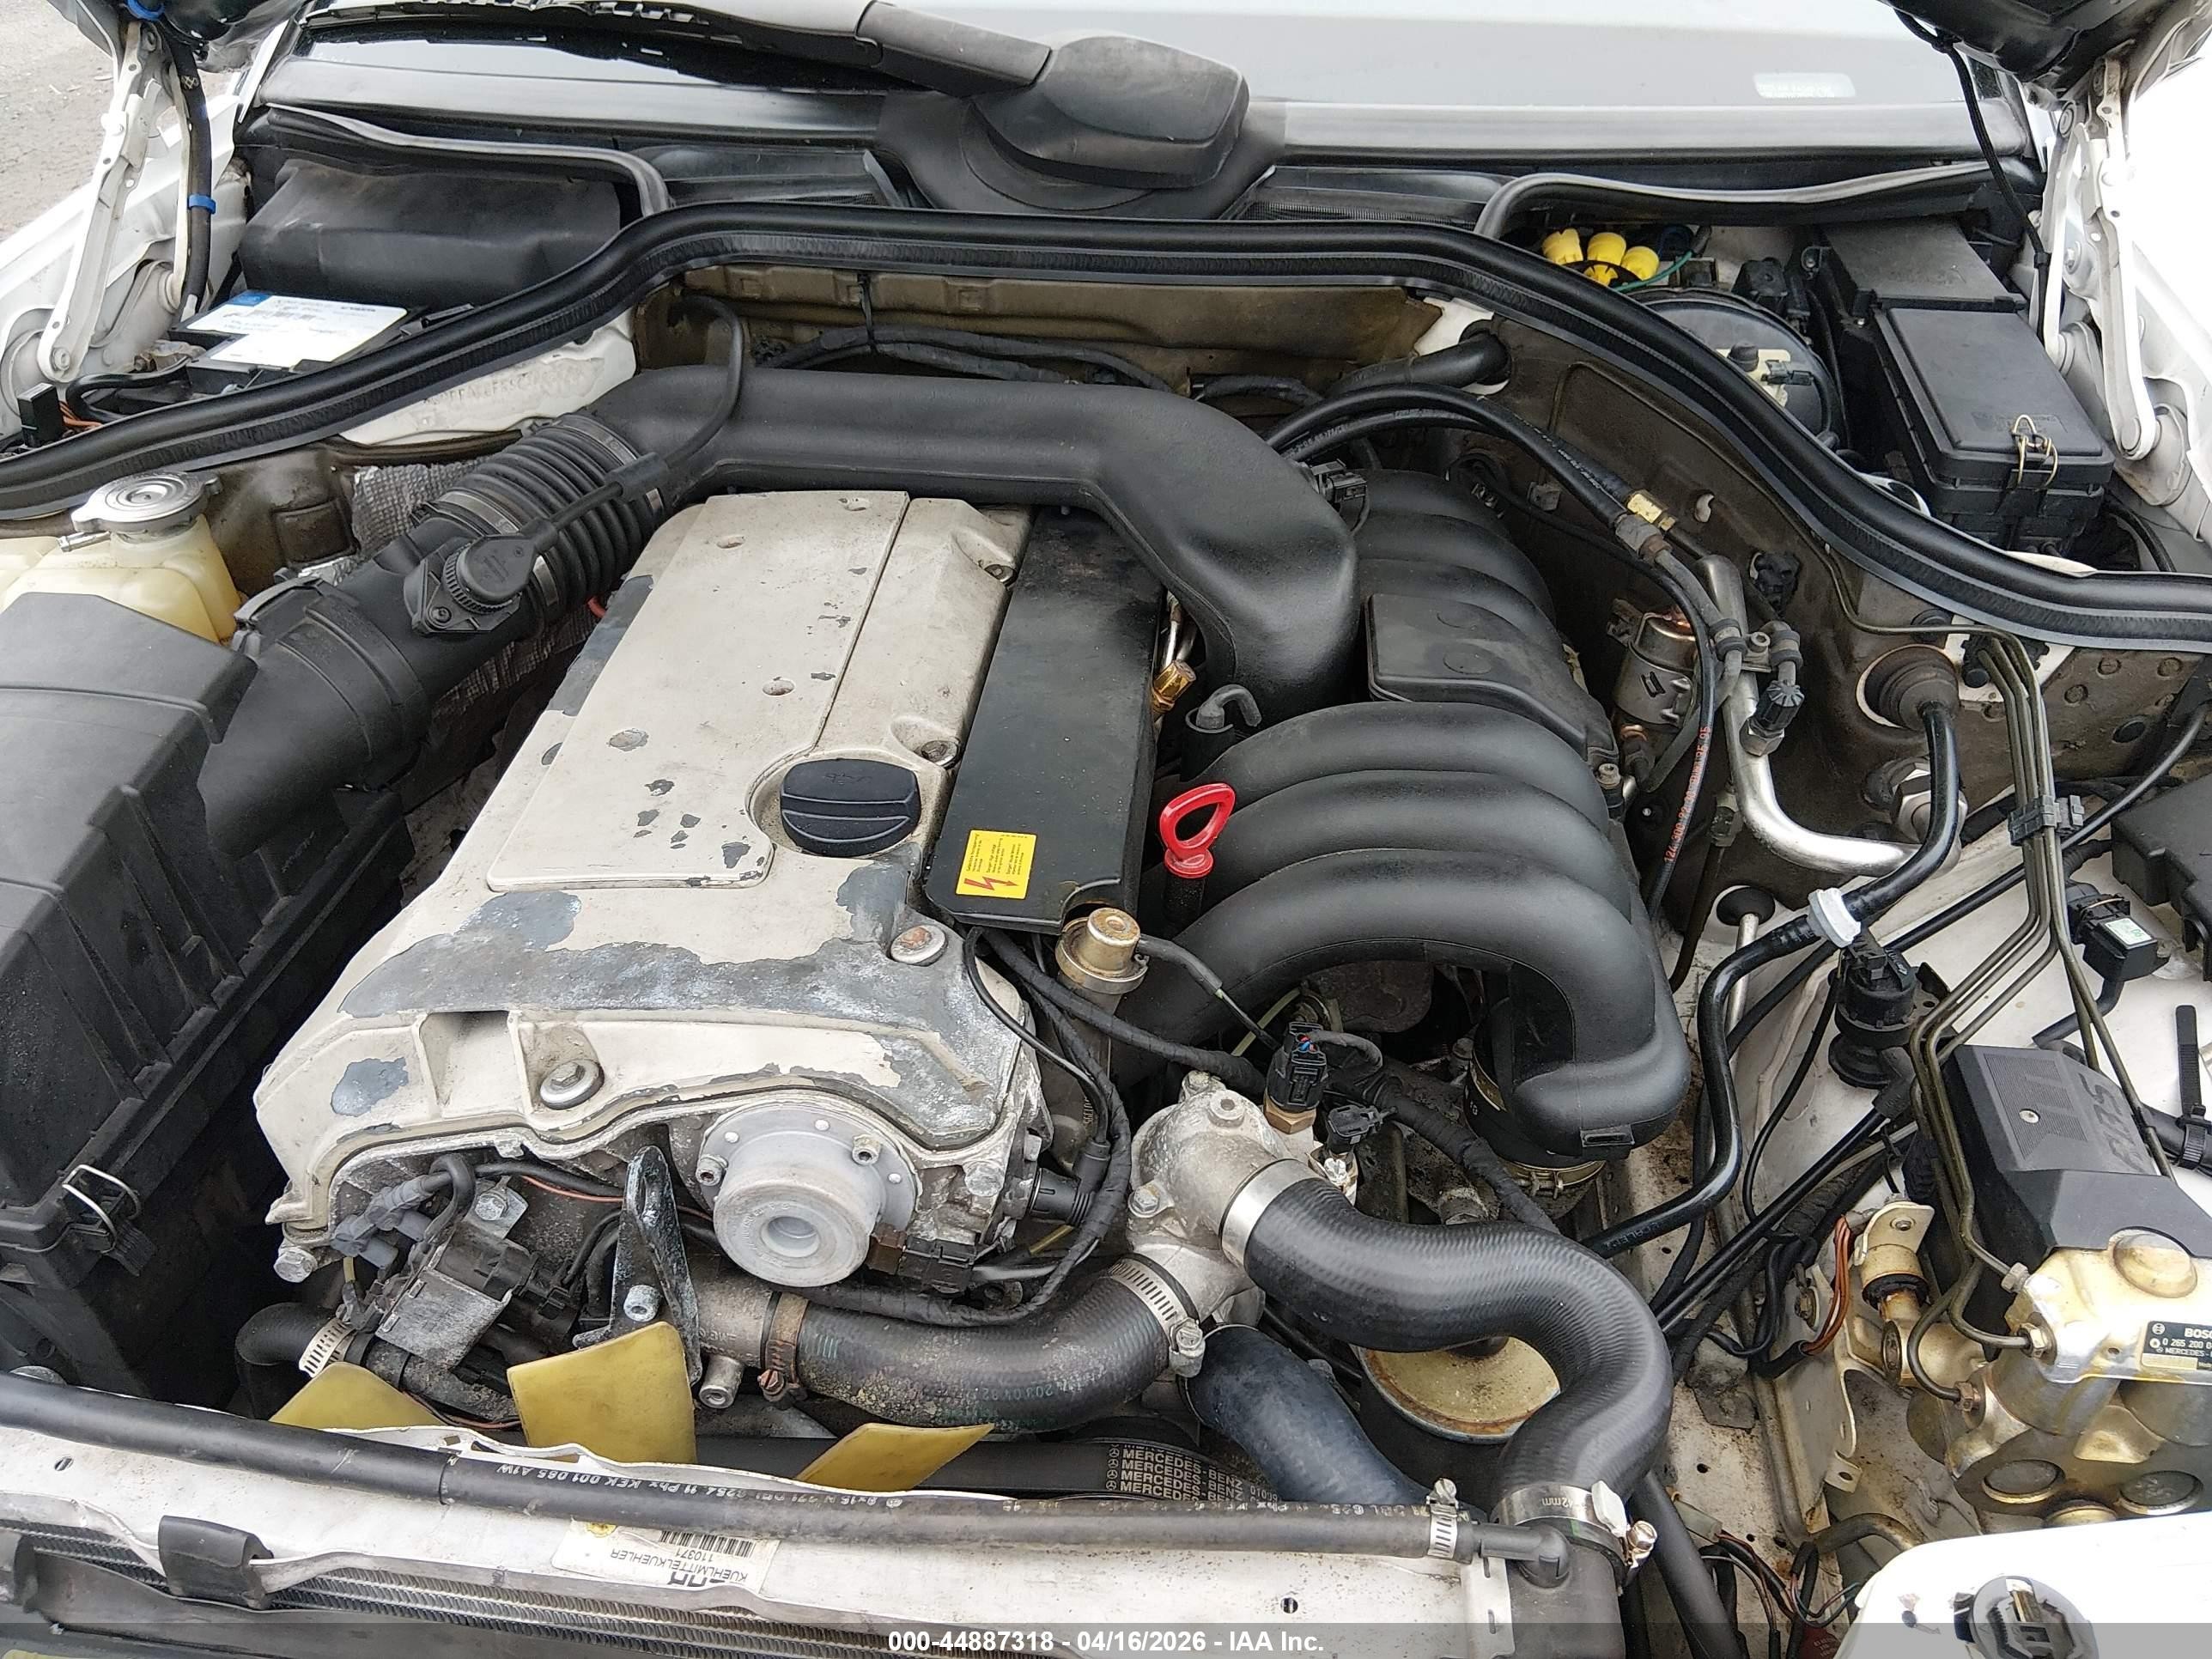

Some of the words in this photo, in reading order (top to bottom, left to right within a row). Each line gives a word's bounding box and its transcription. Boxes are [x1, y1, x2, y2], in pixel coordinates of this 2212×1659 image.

[2205, 1341, 2212, 1350] 0
[675, 1549, 714, 1563] 110371
[611, 1548, 749, 1582] KUEHLMITTELKUEHLER
